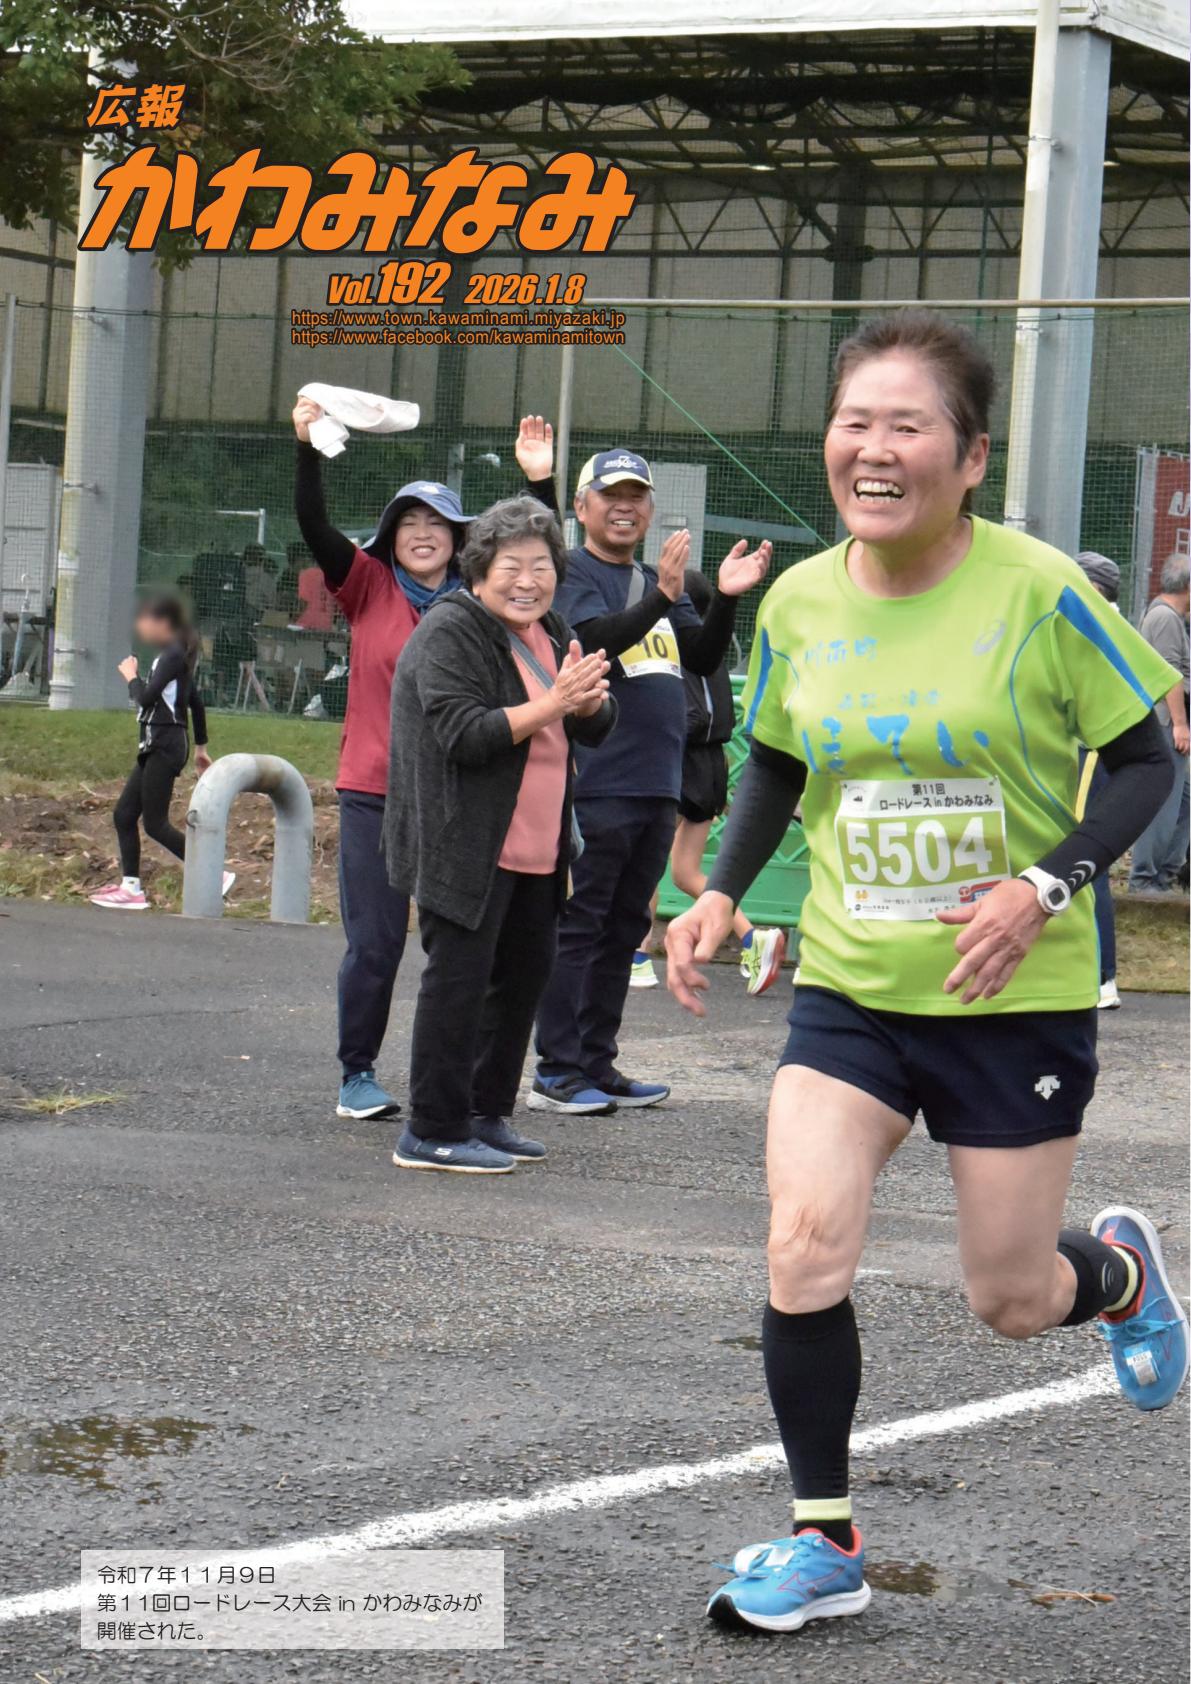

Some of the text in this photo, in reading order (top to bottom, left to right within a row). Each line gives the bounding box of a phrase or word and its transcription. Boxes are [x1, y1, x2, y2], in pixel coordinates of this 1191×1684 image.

[911, 782, 946, 796] 第11回
[879, 797, 932, 811] ロードレース
[944, 794, 995, 808] かわみなみ
[845, 816, 993, 886] 5504
